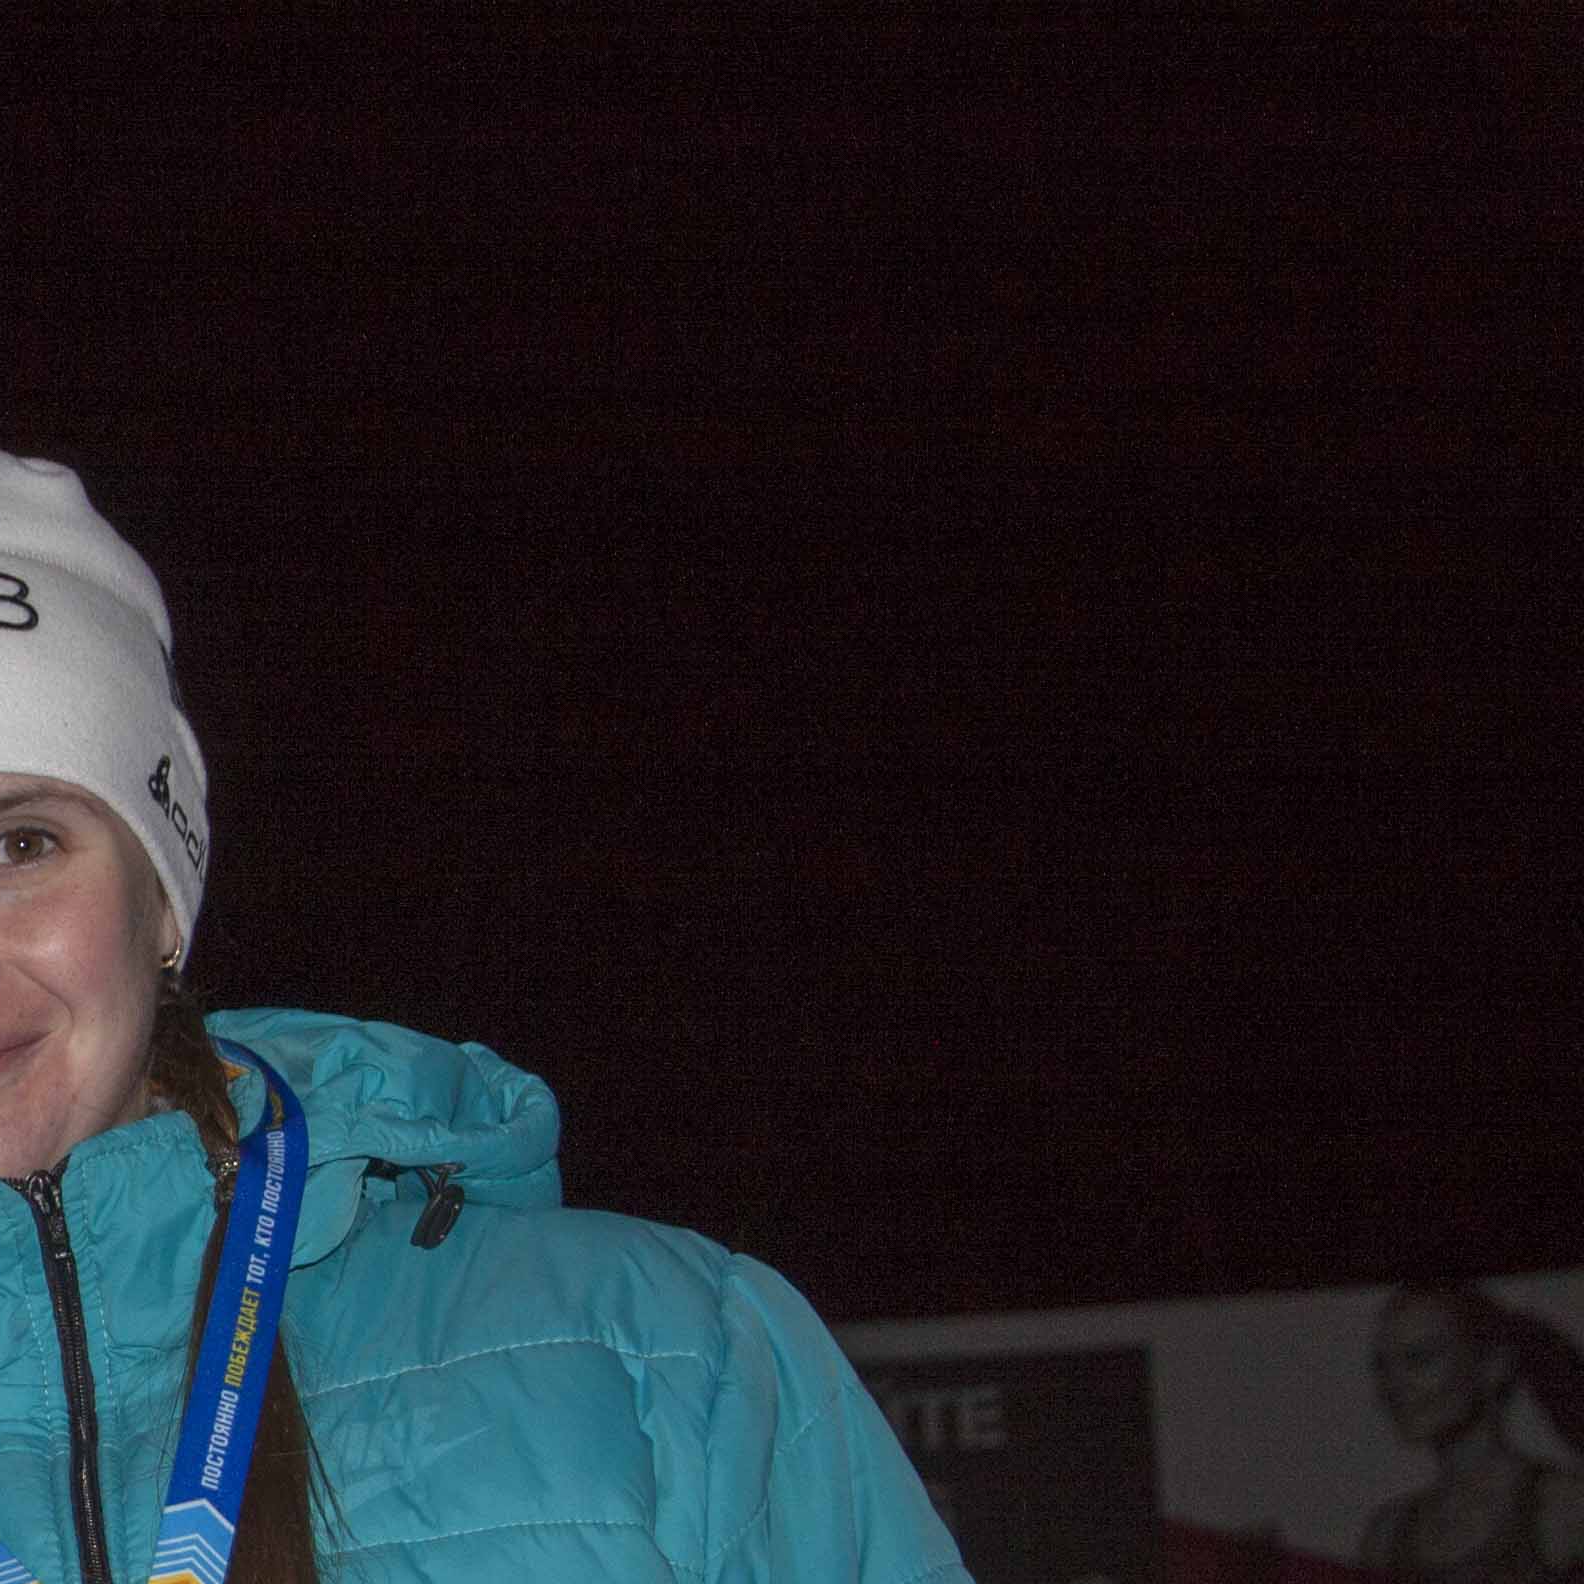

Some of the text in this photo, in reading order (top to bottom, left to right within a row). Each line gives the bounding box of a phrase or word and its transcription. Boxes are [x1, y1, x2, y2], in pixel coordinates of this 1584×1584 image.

[261, 1130, 285, 1214] ПОСТОЯННО
[246, 1250, 272, 1284] ТОТ,
[254, 1215, 275, 1247] КТО
[225, 1286, 262, 1388] ПОБЕЖДАЕТ
[200, 1390, 238, 1491] ПОСТОЯННО
